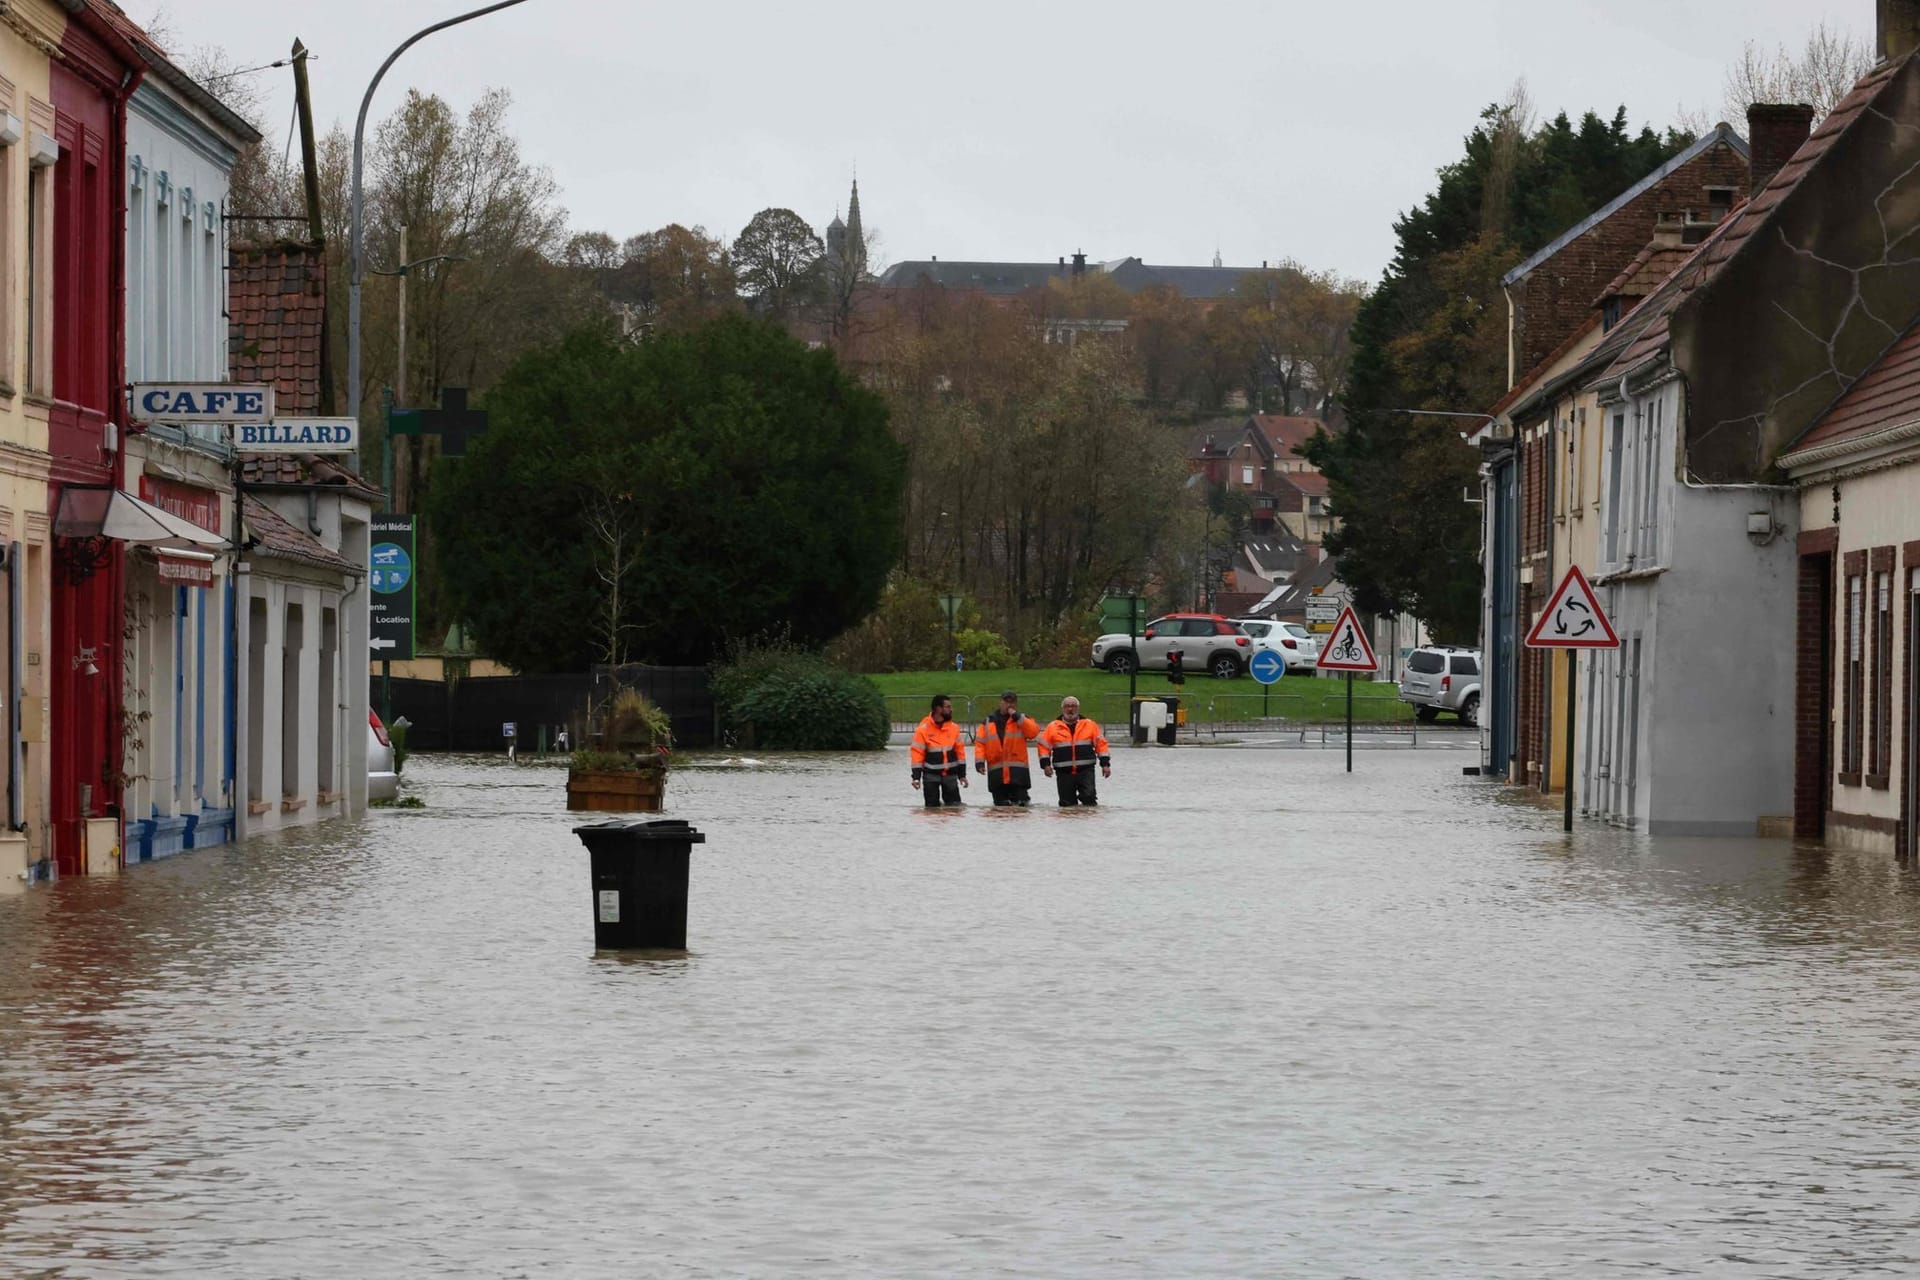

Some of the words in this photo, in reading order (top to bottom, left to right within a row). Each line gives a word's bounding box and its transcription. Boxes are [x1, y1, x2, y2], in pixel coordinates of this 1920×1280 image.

[142, 391, 263, 414] CAFE
[241, 426, 352, 444] BILLARD
[388, 522, 412, 531] Médical
[375, 615, 411, 624] Location
